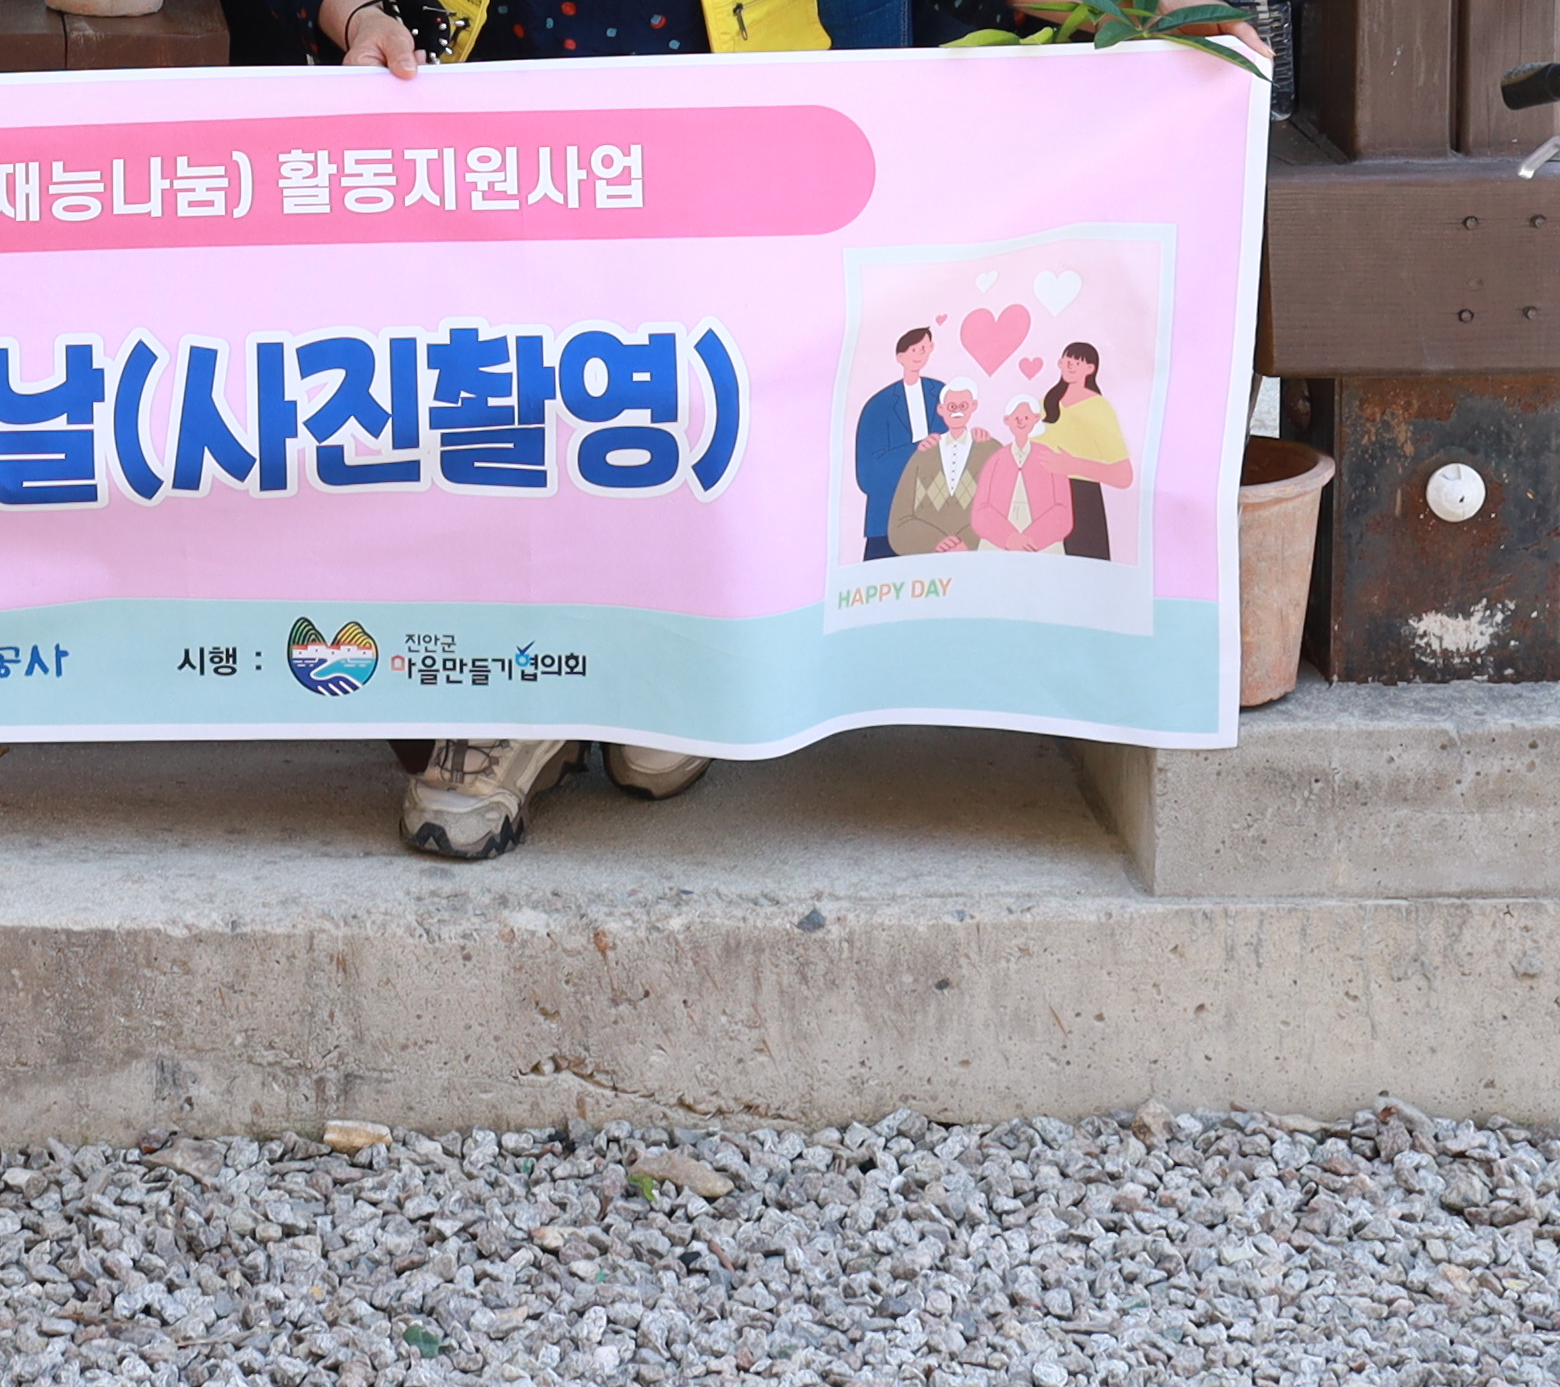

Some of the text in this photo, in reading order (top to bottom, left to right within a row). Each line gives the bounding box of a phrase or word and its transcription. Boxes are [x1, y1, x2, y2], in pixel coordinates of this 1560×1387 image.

[278, 144, 644, 214] 활동지원사업
[838, 577, 952, 609] HAPPY DAY
[405, 634, 456, 653] 진안군
[177, 646, 237, 676] 시행
[391, 641, 587, 686] 마을만들기협의회
